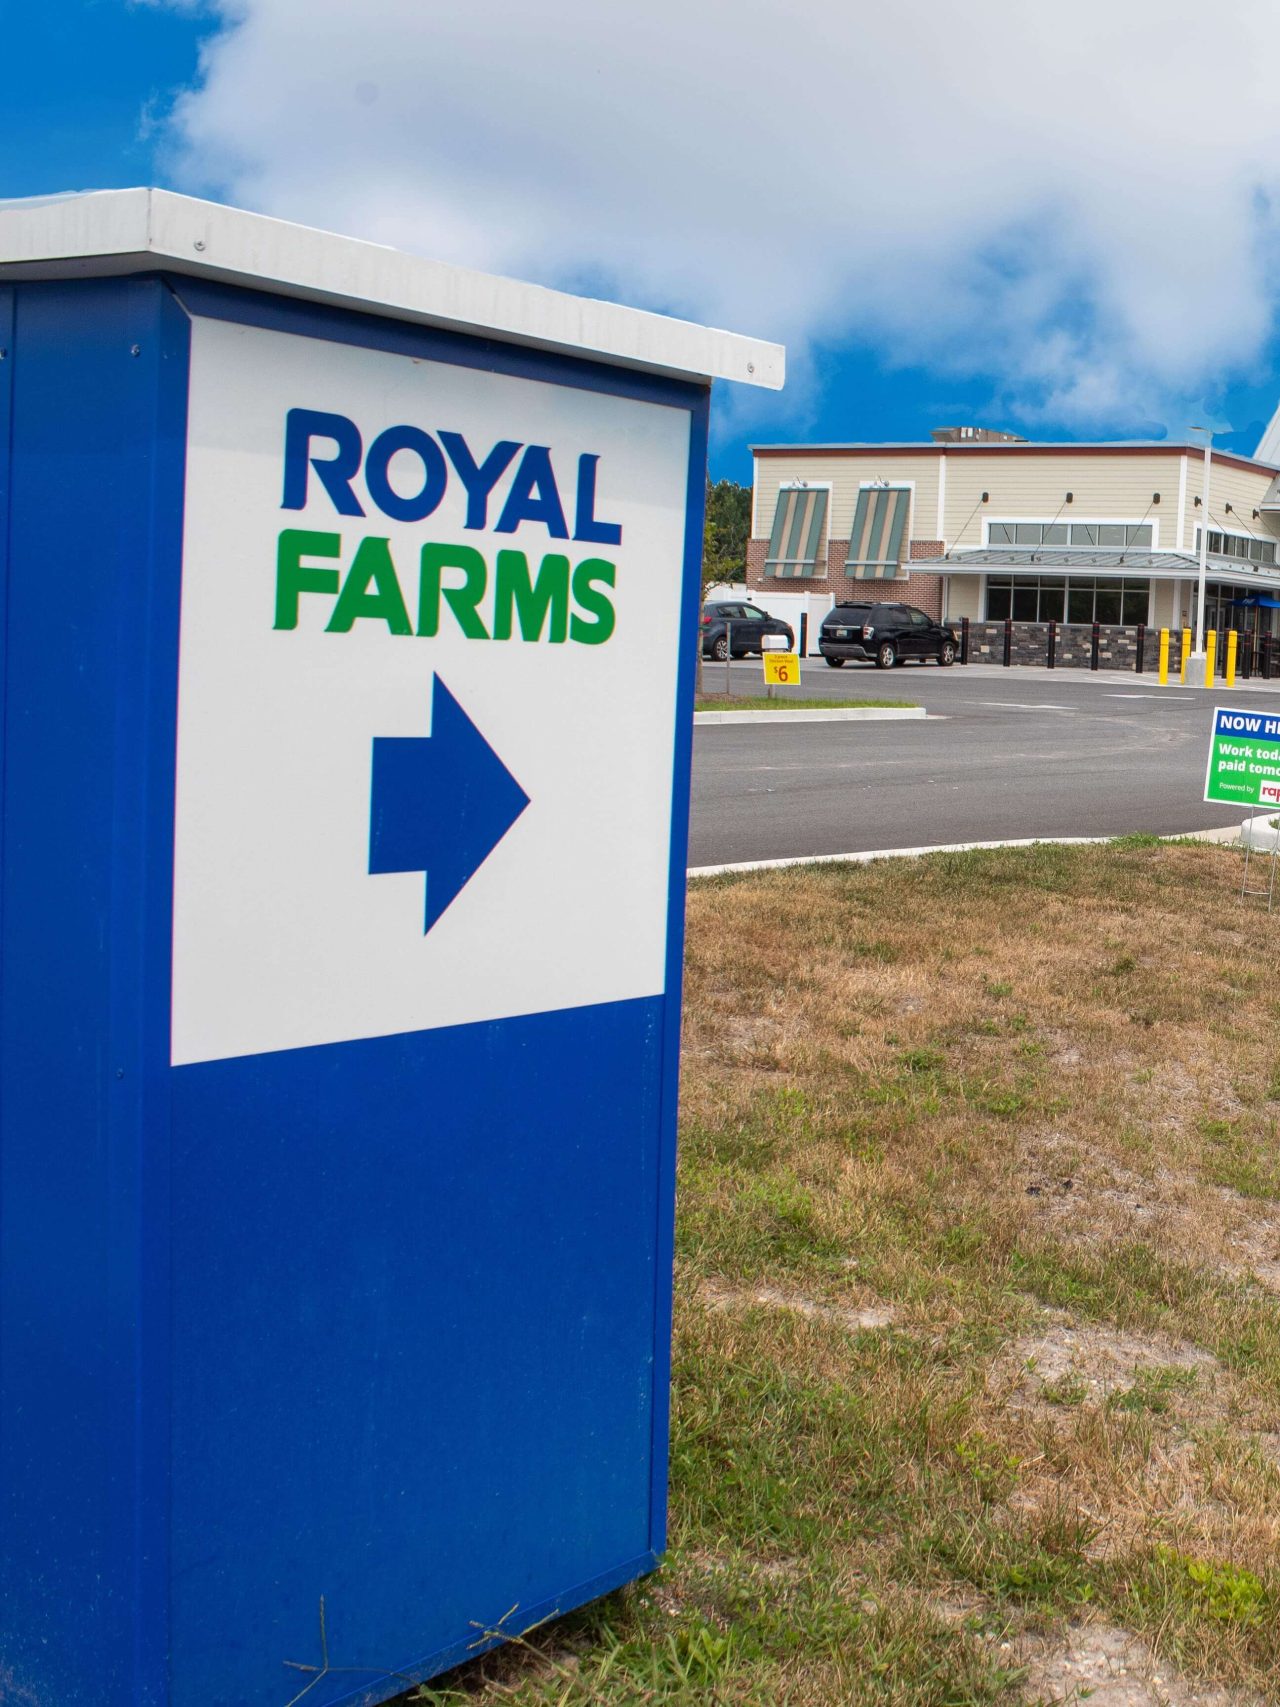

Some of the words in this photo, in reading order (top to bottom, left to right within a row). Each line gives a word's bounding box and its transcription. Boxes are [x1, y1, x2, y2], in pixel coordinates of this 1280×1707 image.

[280, 407, 622, 546] ROYAL
[272, 528, 617, 645] FARMS
[773, 666, 788, 681] $6
[1220, 715, 1262, 732] NOW
[1218, 743, 1253, 758] Work
[1218, 759, 1246, 773] paid
[1219, 782, 1246, 792] Powered
[1247, 784, 1254, 793] by
